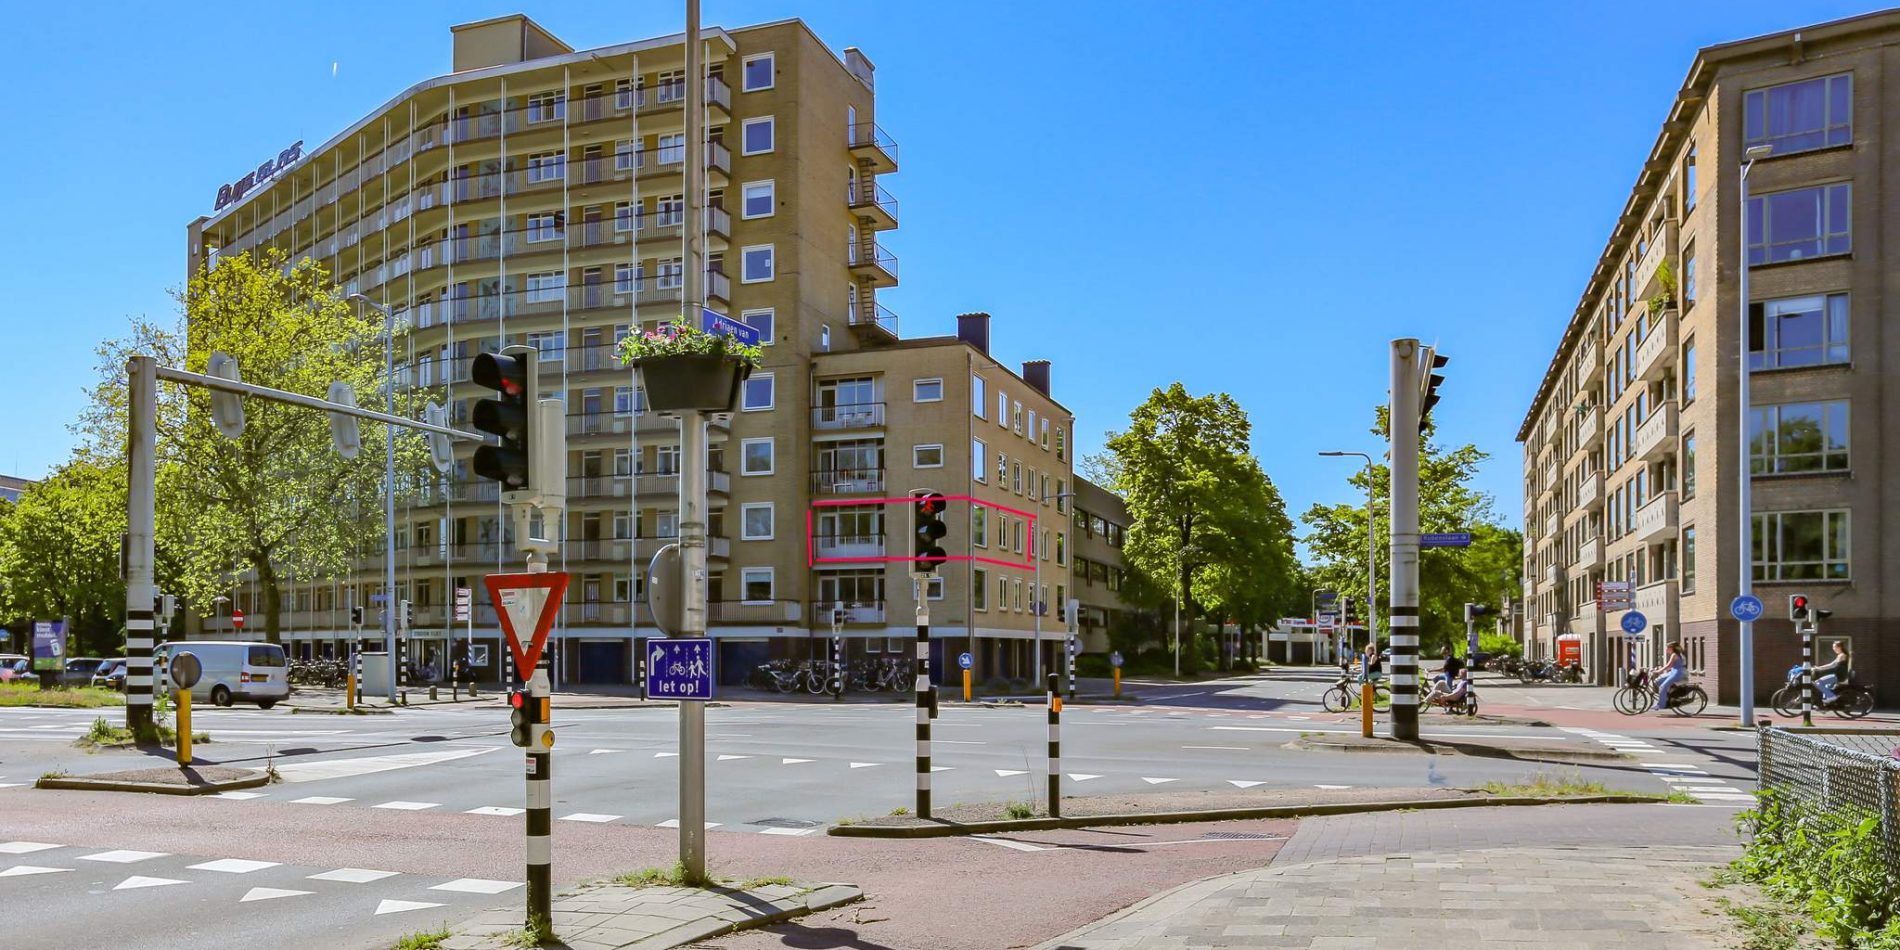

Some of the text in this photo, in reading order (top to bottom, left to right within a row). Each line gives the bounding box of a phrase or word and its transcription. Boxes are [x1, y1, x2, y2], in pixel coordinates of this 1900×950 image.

[739, 328, 750, 339] van
[659, 680, 699, 695] let op!
